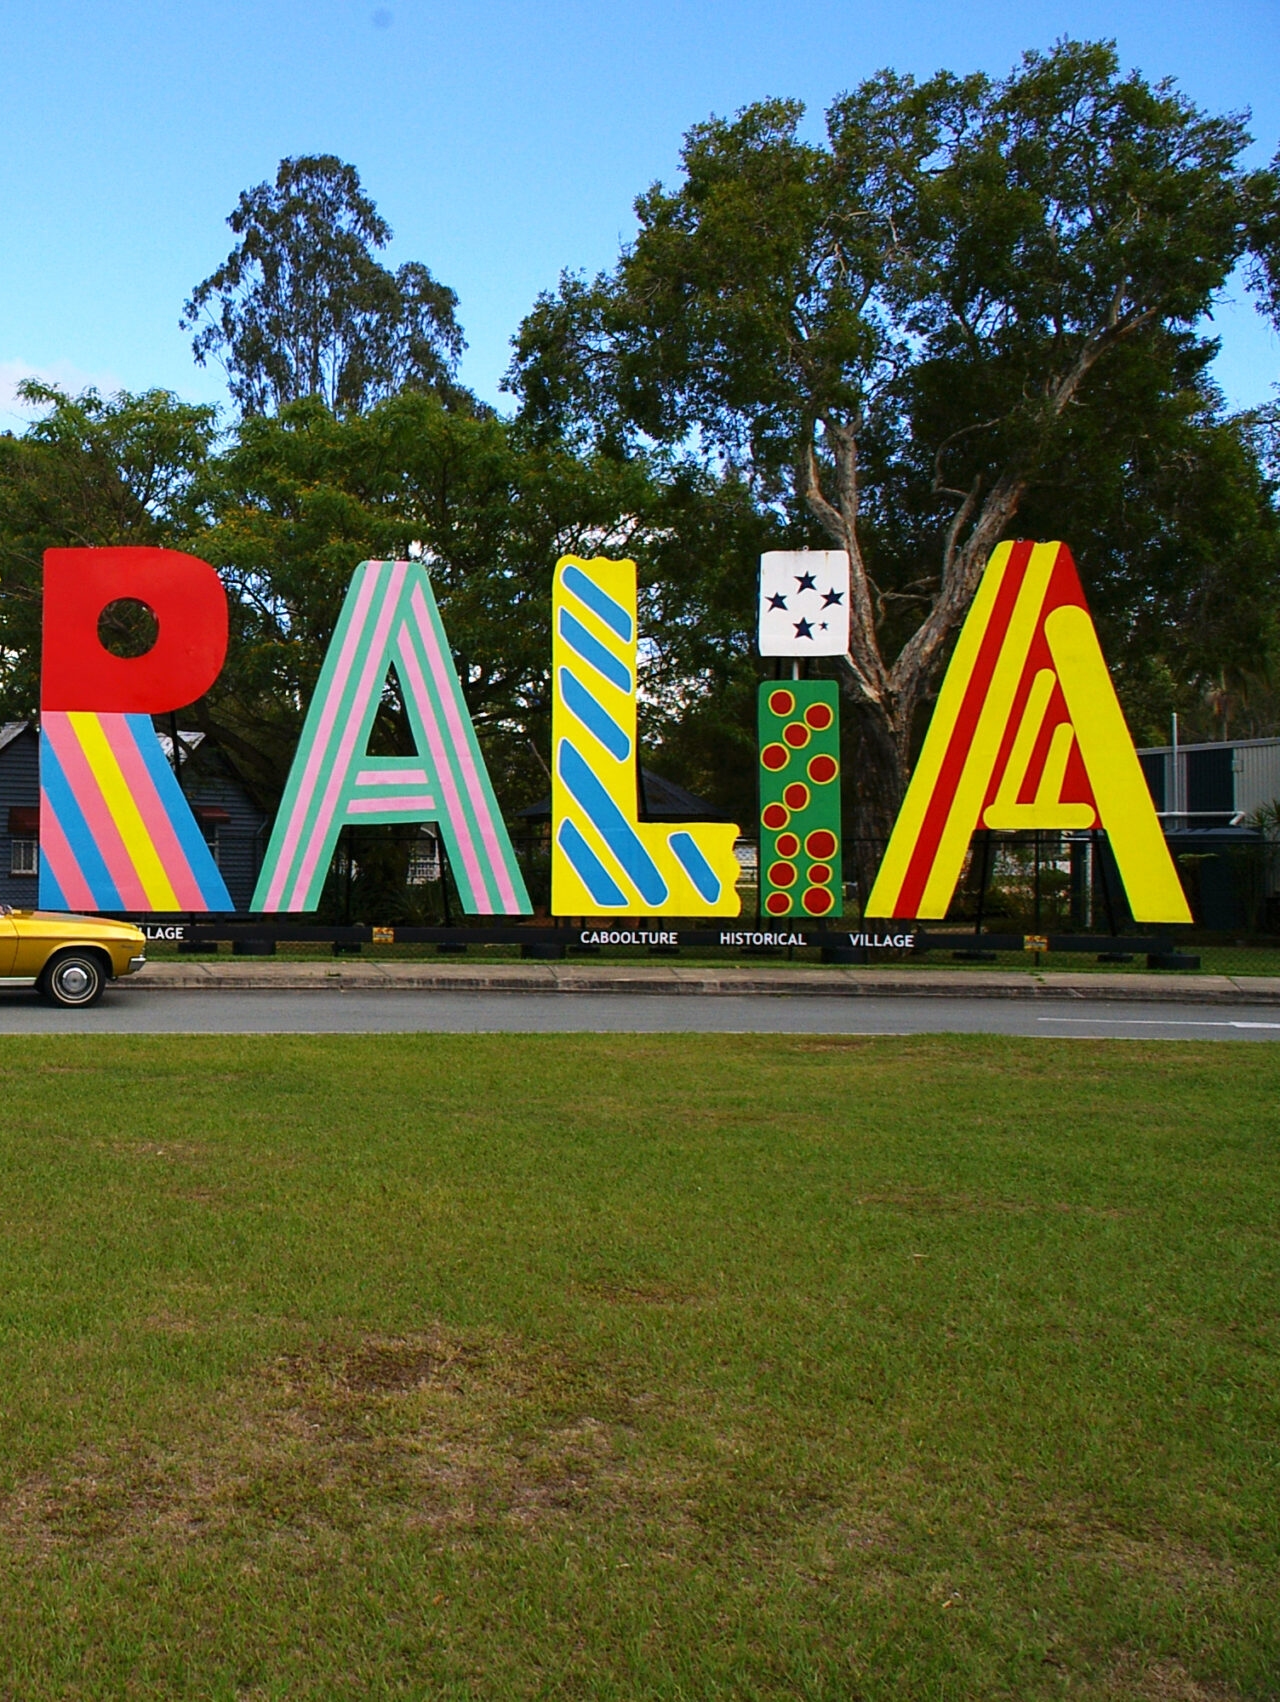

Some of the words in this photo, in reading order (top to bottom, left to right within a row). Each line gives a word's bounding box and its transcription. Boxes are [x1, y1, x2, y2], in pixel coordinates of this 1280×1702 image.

[580, 931, 679, 945] CABOOLTURE
[719, 931, 808, 946] HISTORICAL
[848, 933, 915, 948] VILLAGE
